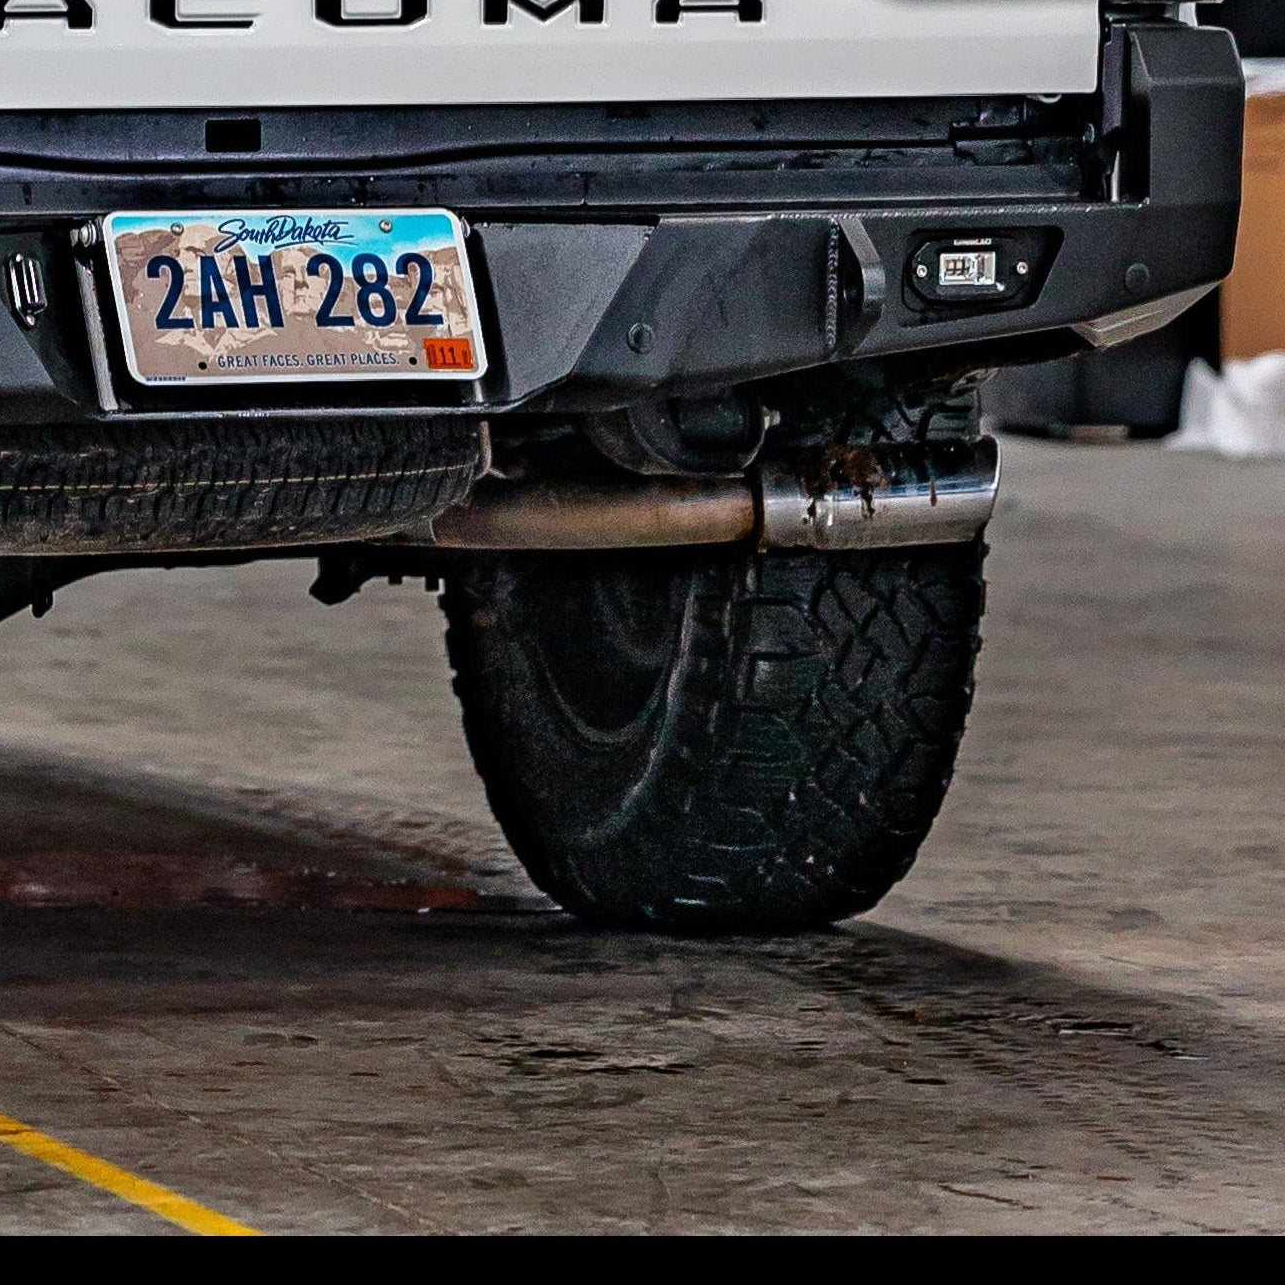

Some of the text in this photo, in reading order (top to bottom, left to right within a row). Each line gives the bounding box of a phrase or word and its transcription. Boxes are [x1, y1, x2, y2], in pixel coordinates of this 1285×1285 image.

[147, 252, 445, 330] 2AH 282
[218, 354, 258, 368] GREAT
[306, 353, 347, 366] GREAT
